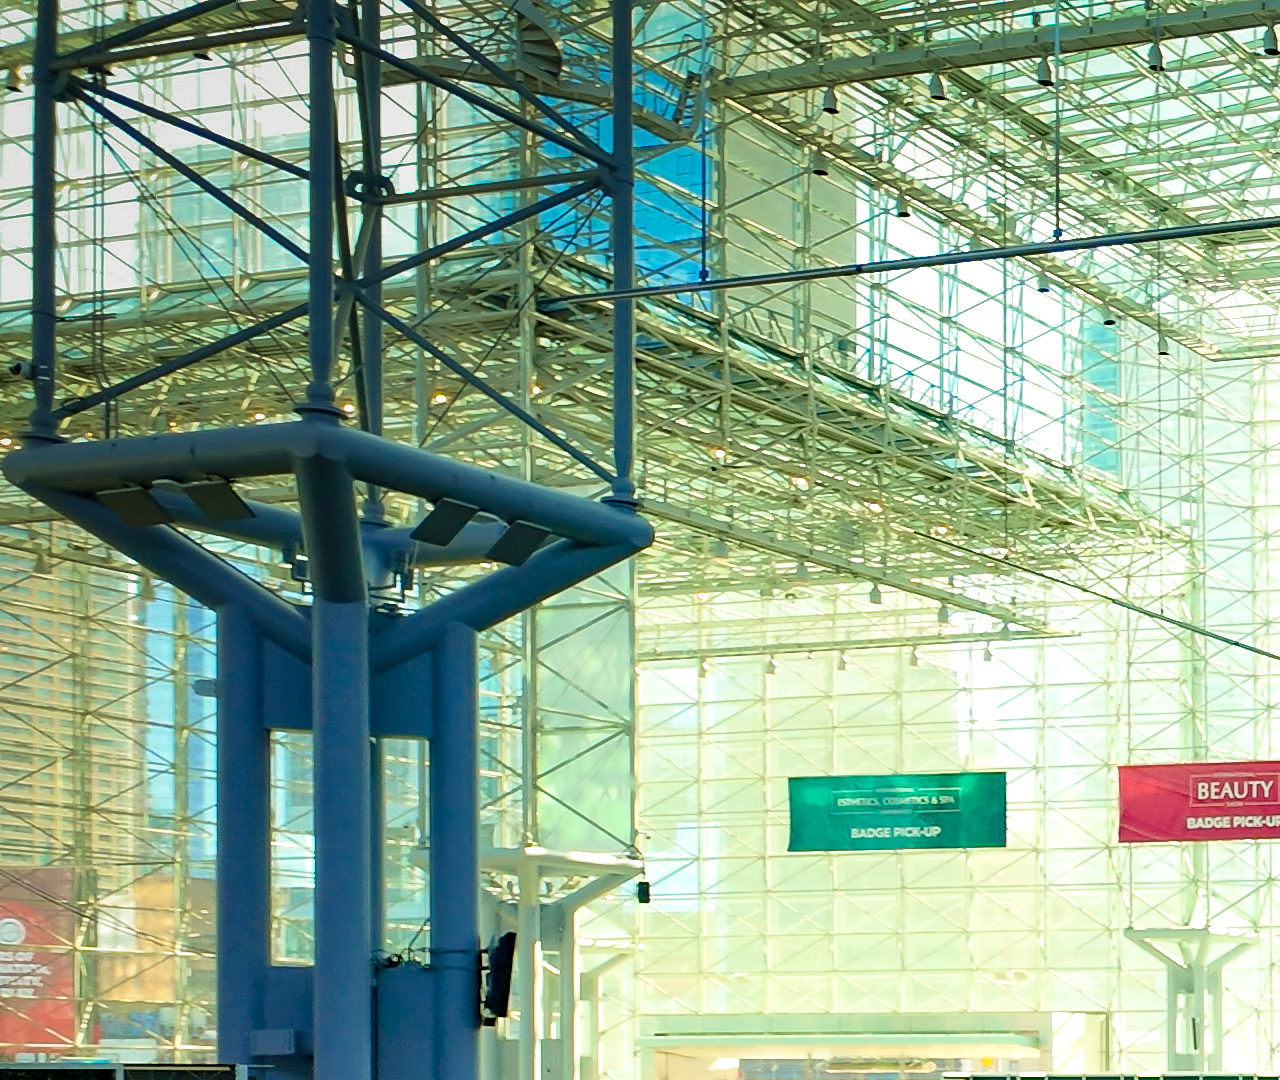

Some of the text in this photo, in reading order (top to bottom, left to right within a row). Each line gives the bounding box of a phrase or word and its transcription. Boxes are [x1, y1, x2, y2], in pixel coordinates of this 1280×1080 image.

[1197, 780, 1274, 800] BEAUTY
[1186, 816, 1231, 829] BADGE
[850, 825, 942, 839] BADGE PICK-UP
